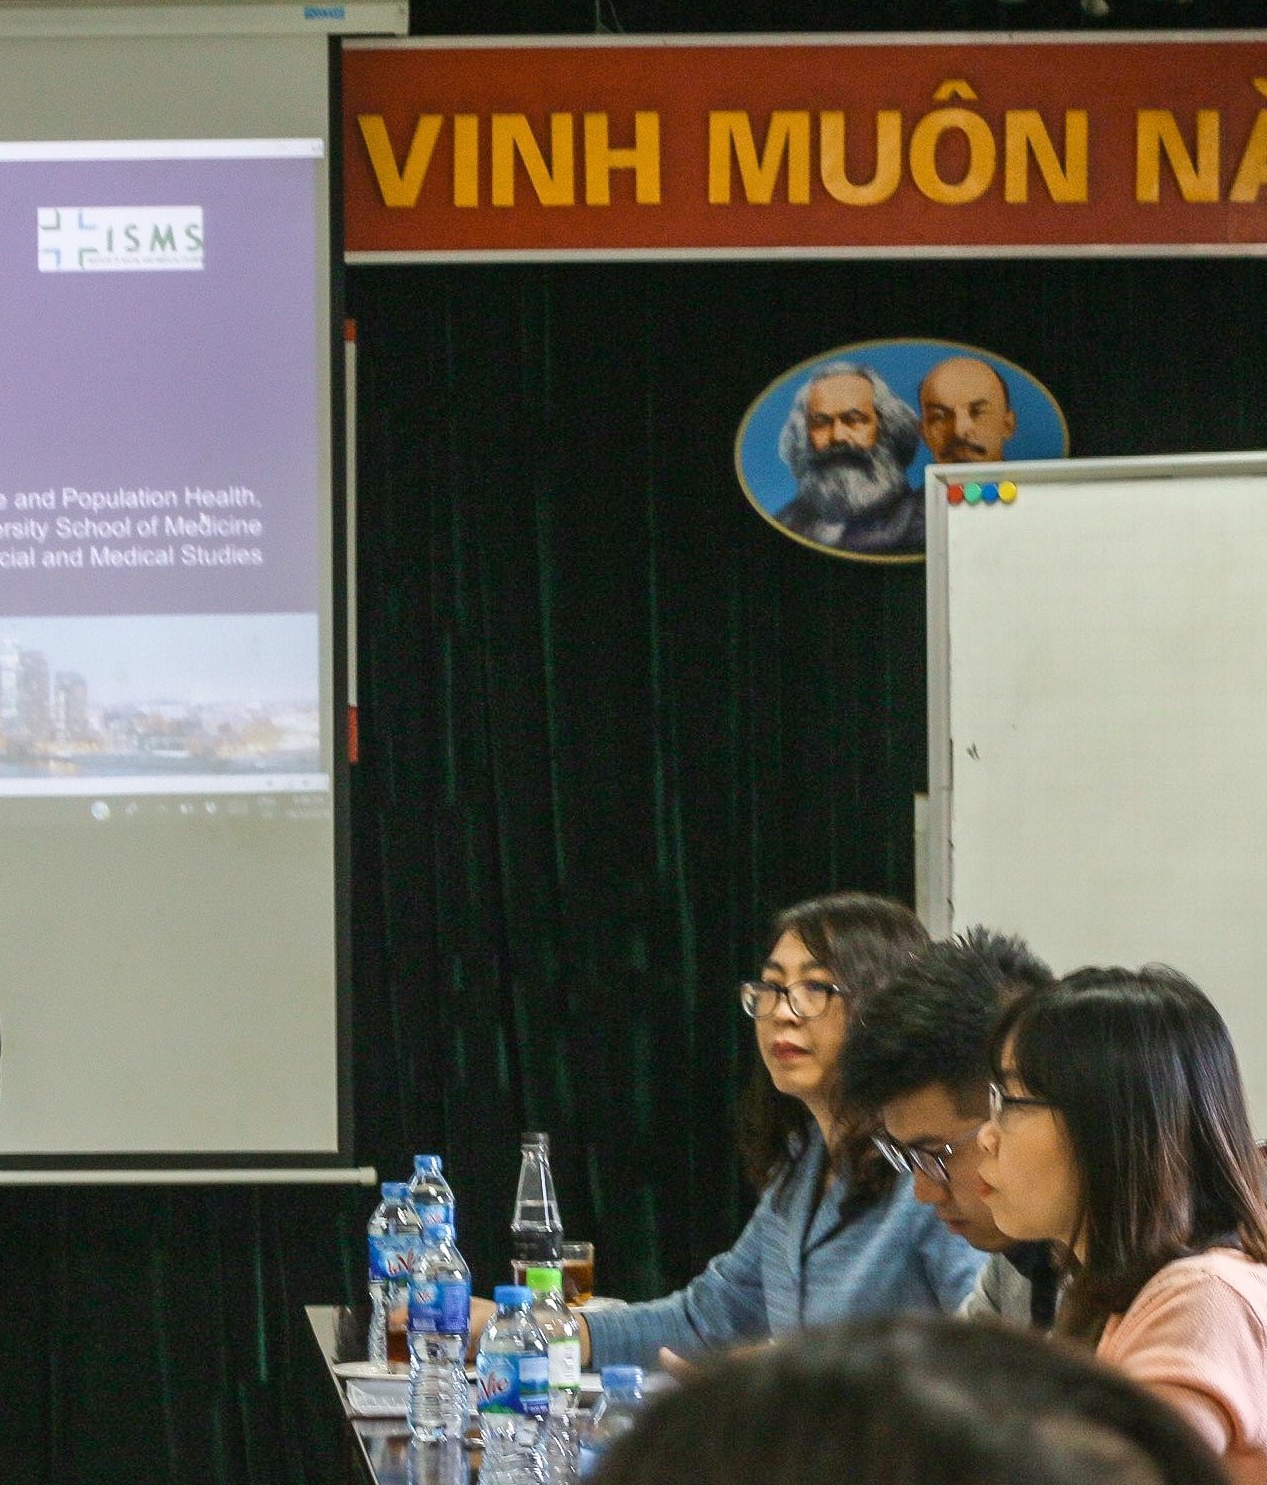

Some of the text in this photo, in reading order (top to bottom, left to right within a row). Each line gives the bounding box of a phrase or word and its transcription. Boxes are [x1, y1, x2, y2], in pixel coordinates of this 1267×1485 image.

[357, 110, 661, 208] VINH
[709, 78, 1089, 206] MUÔN
[105, 222, 204, 253] ISMS
[13, 487, 55, 510] and
[61, 486, 178, 513] Population
[55, 515, 131, 538] School
[137, 515, 159, 538] of
[164, 514, 263, 538] Medicine
[42, 544, 83, 568] and
[90, 543, 174, 567] Medical
[180, 542, 263, 566] Studies
